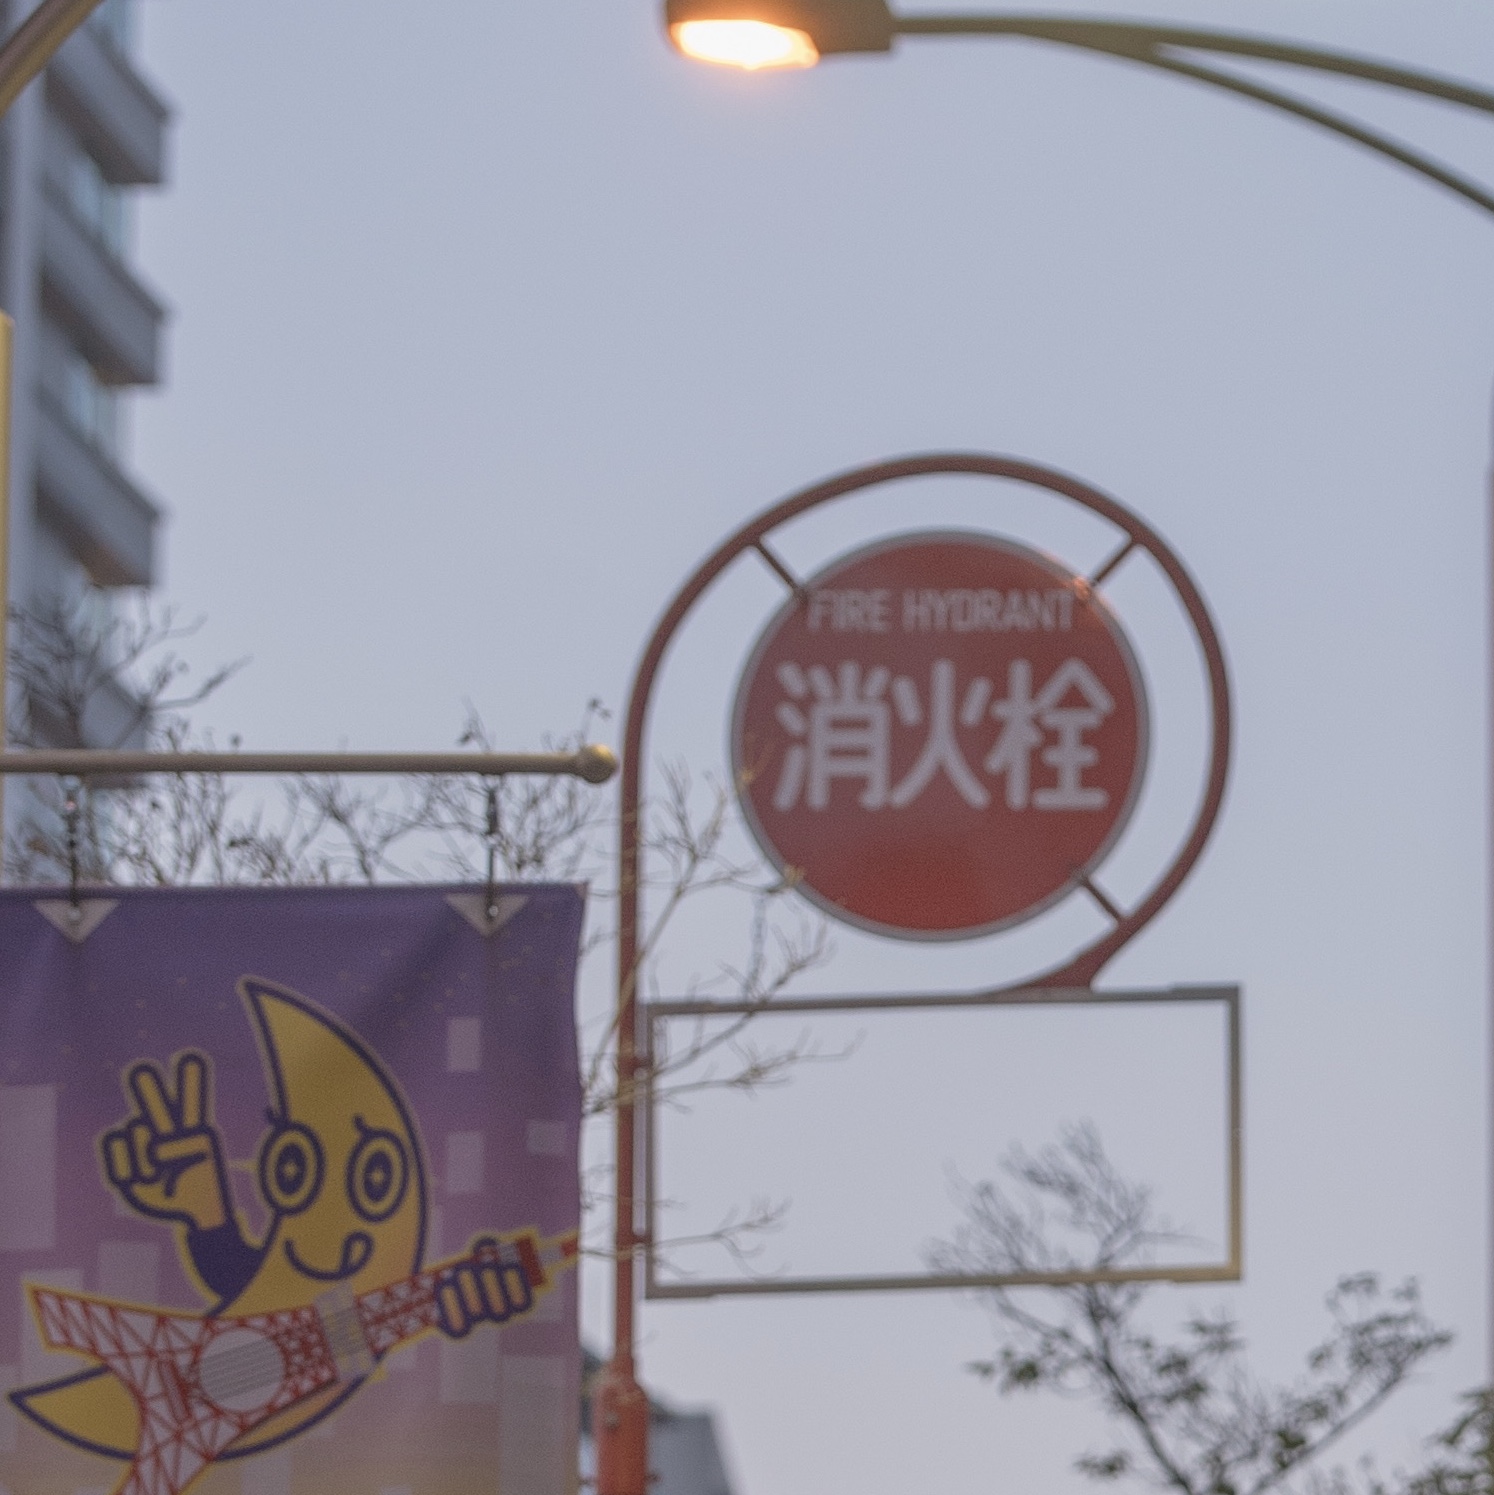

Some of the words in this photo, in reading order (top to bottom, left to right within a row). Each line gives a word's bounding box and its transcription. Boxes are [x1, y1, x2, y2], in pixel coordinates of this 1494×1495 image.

[807, 588, 891, 631] FIRE
[901, 587, 1075, 632] HYDRANT
[774, 658, 1117, 811] 消火栓
